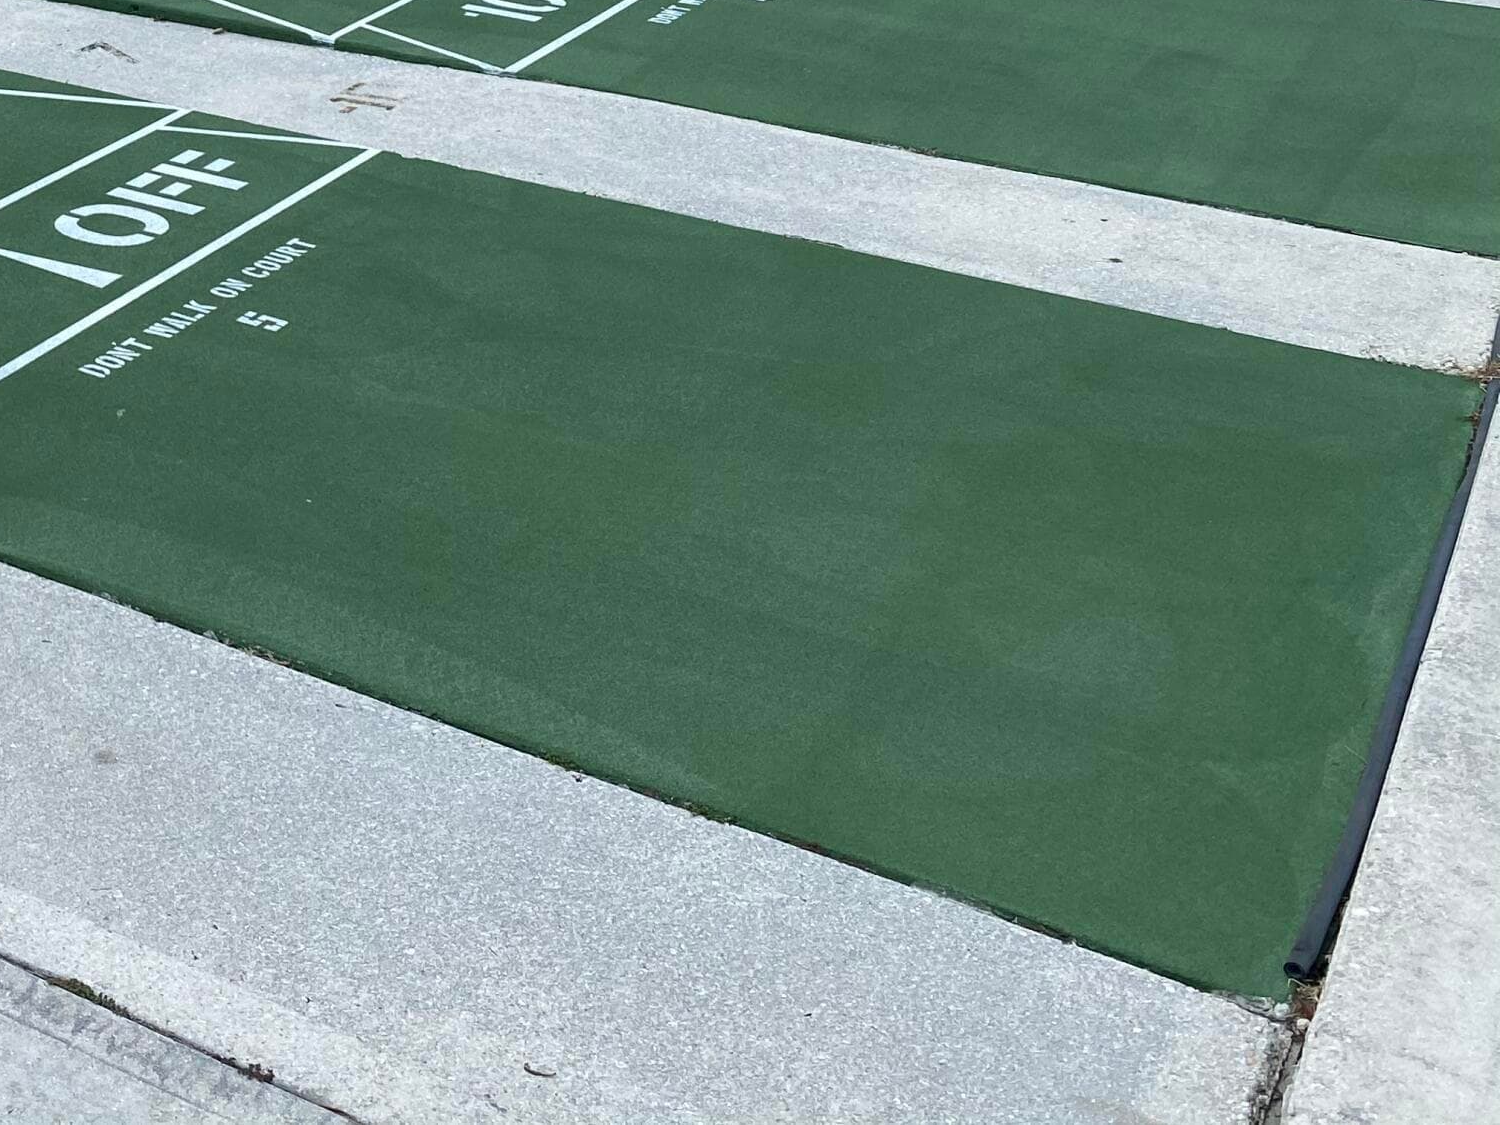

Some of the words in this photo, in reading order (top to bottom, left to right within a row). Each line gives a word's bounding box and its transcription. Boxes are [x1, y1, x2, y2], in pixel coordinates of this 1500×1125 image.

[54, 149, 249, 247] OFF
[78, 337, 153, 378] DON'T
[143, 299, 218, 338] WALK
[209, 278, 253, 298] ON
[241, 237, 317, 279] COURT
[236, 310, 289, 332] 5
